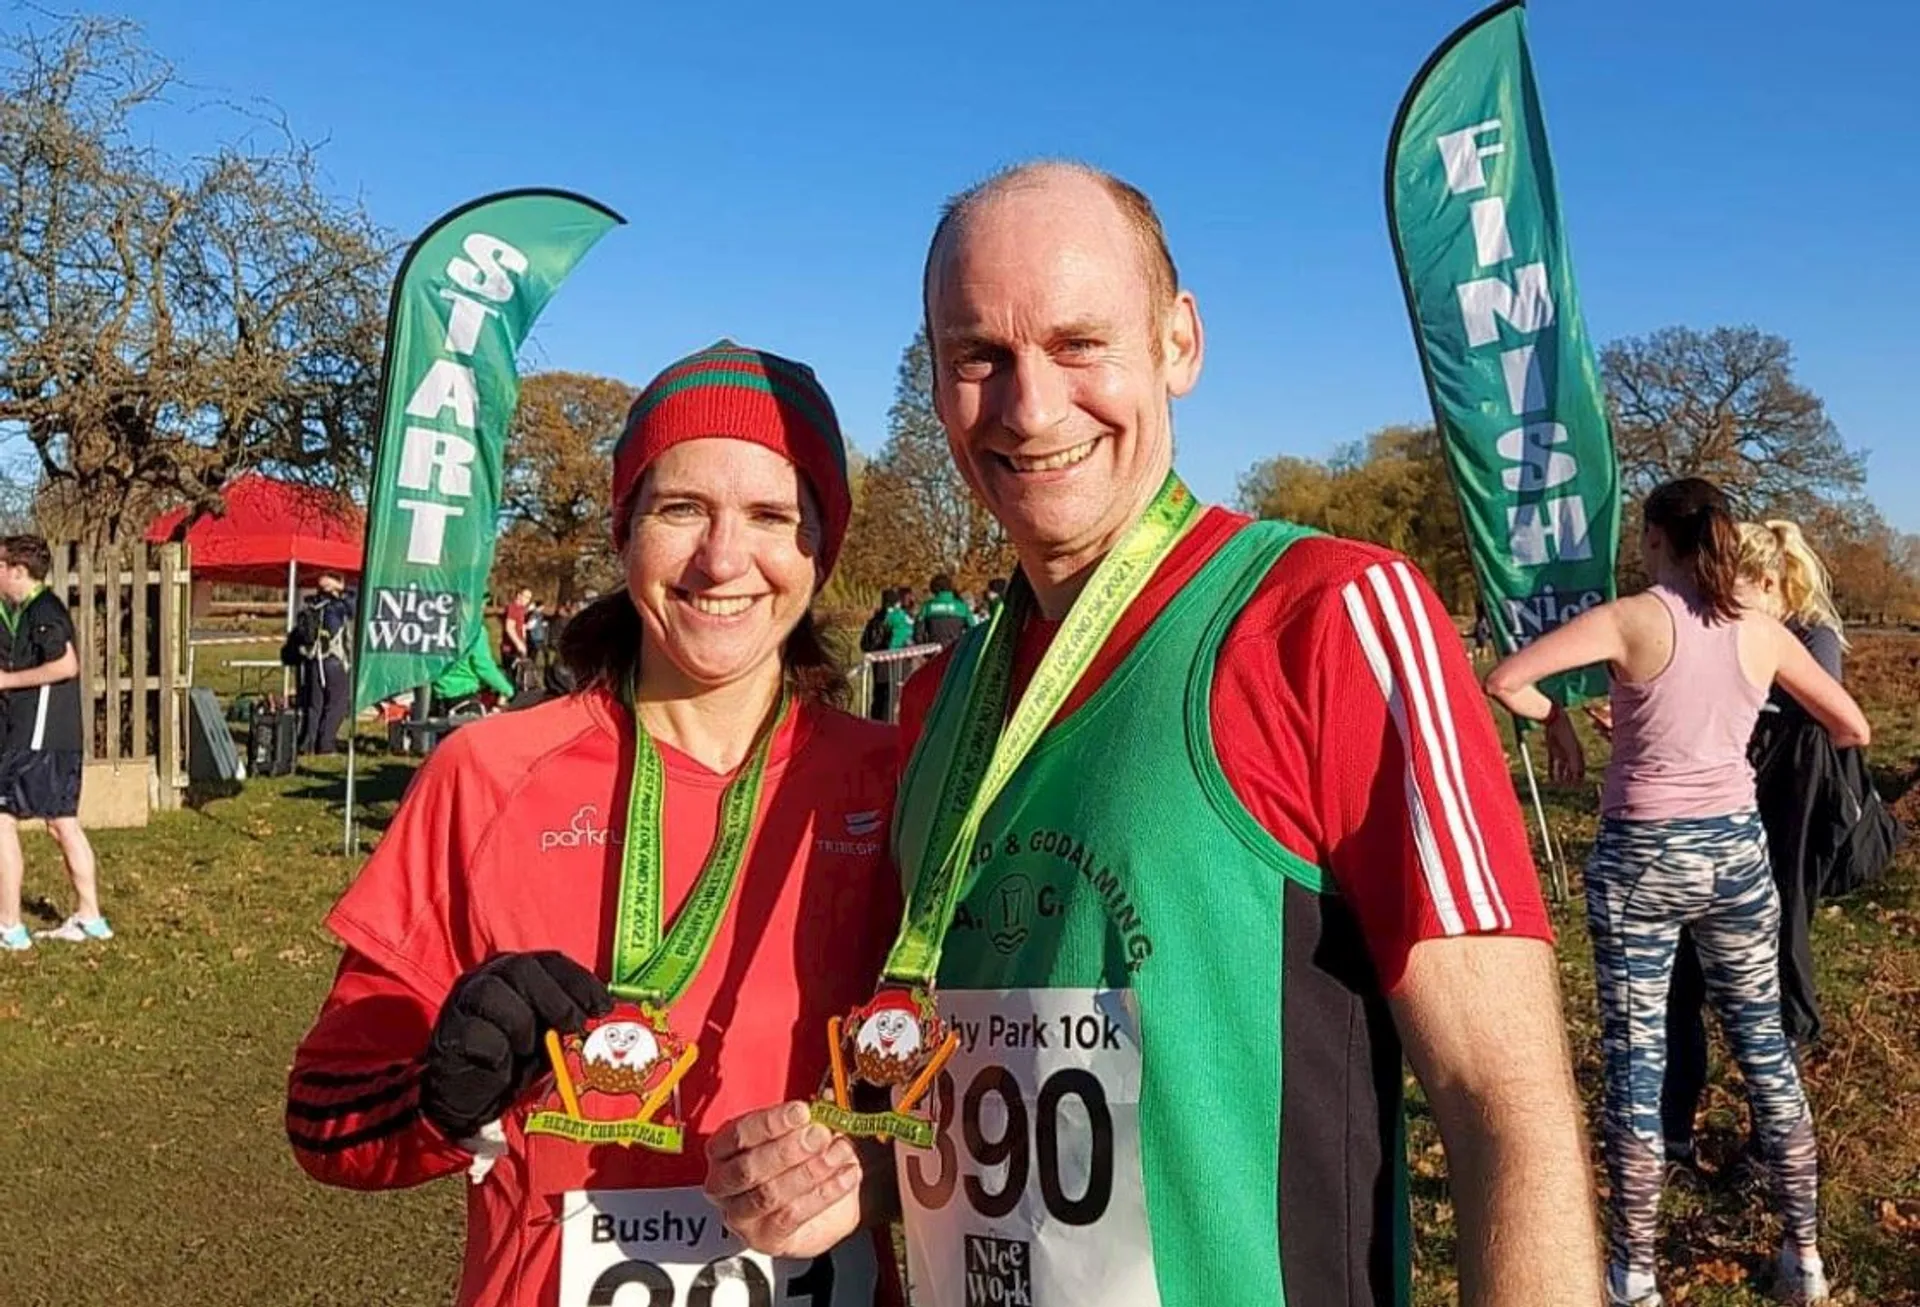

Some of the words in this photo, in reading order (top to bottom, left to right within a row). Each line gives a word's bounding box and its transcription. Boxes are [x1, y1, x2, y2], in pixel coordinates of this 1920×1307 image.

[1437, 118, 1594, 566] FINISH
[396, 232, 529, 566] START
[1098, 556, 1136, 601] 2021
[377, 582, 453, 622] Nice
[368, 616, 458, 653] Work
[541, 805, 625, 852] parkru
[1004, 833, 1021, 856] &
[1030, 830, 1153, 962] GODALMING
[1037, 884, 1064, 917] C.
[630, 907, 648, 950] 2021
[989, 1014, 1049, 1049] Park
[1060, 1014, 1121, 1050] 10k
[542, 1114, 586, 1137] MERRY
[590, 1121, 666, 1145] CHRISTMAS
[907, 1065, 1114, 1227] 390
[591, 1210, 707, 1247] Bushy
[968, 1229, 1024, 1275] Nice
